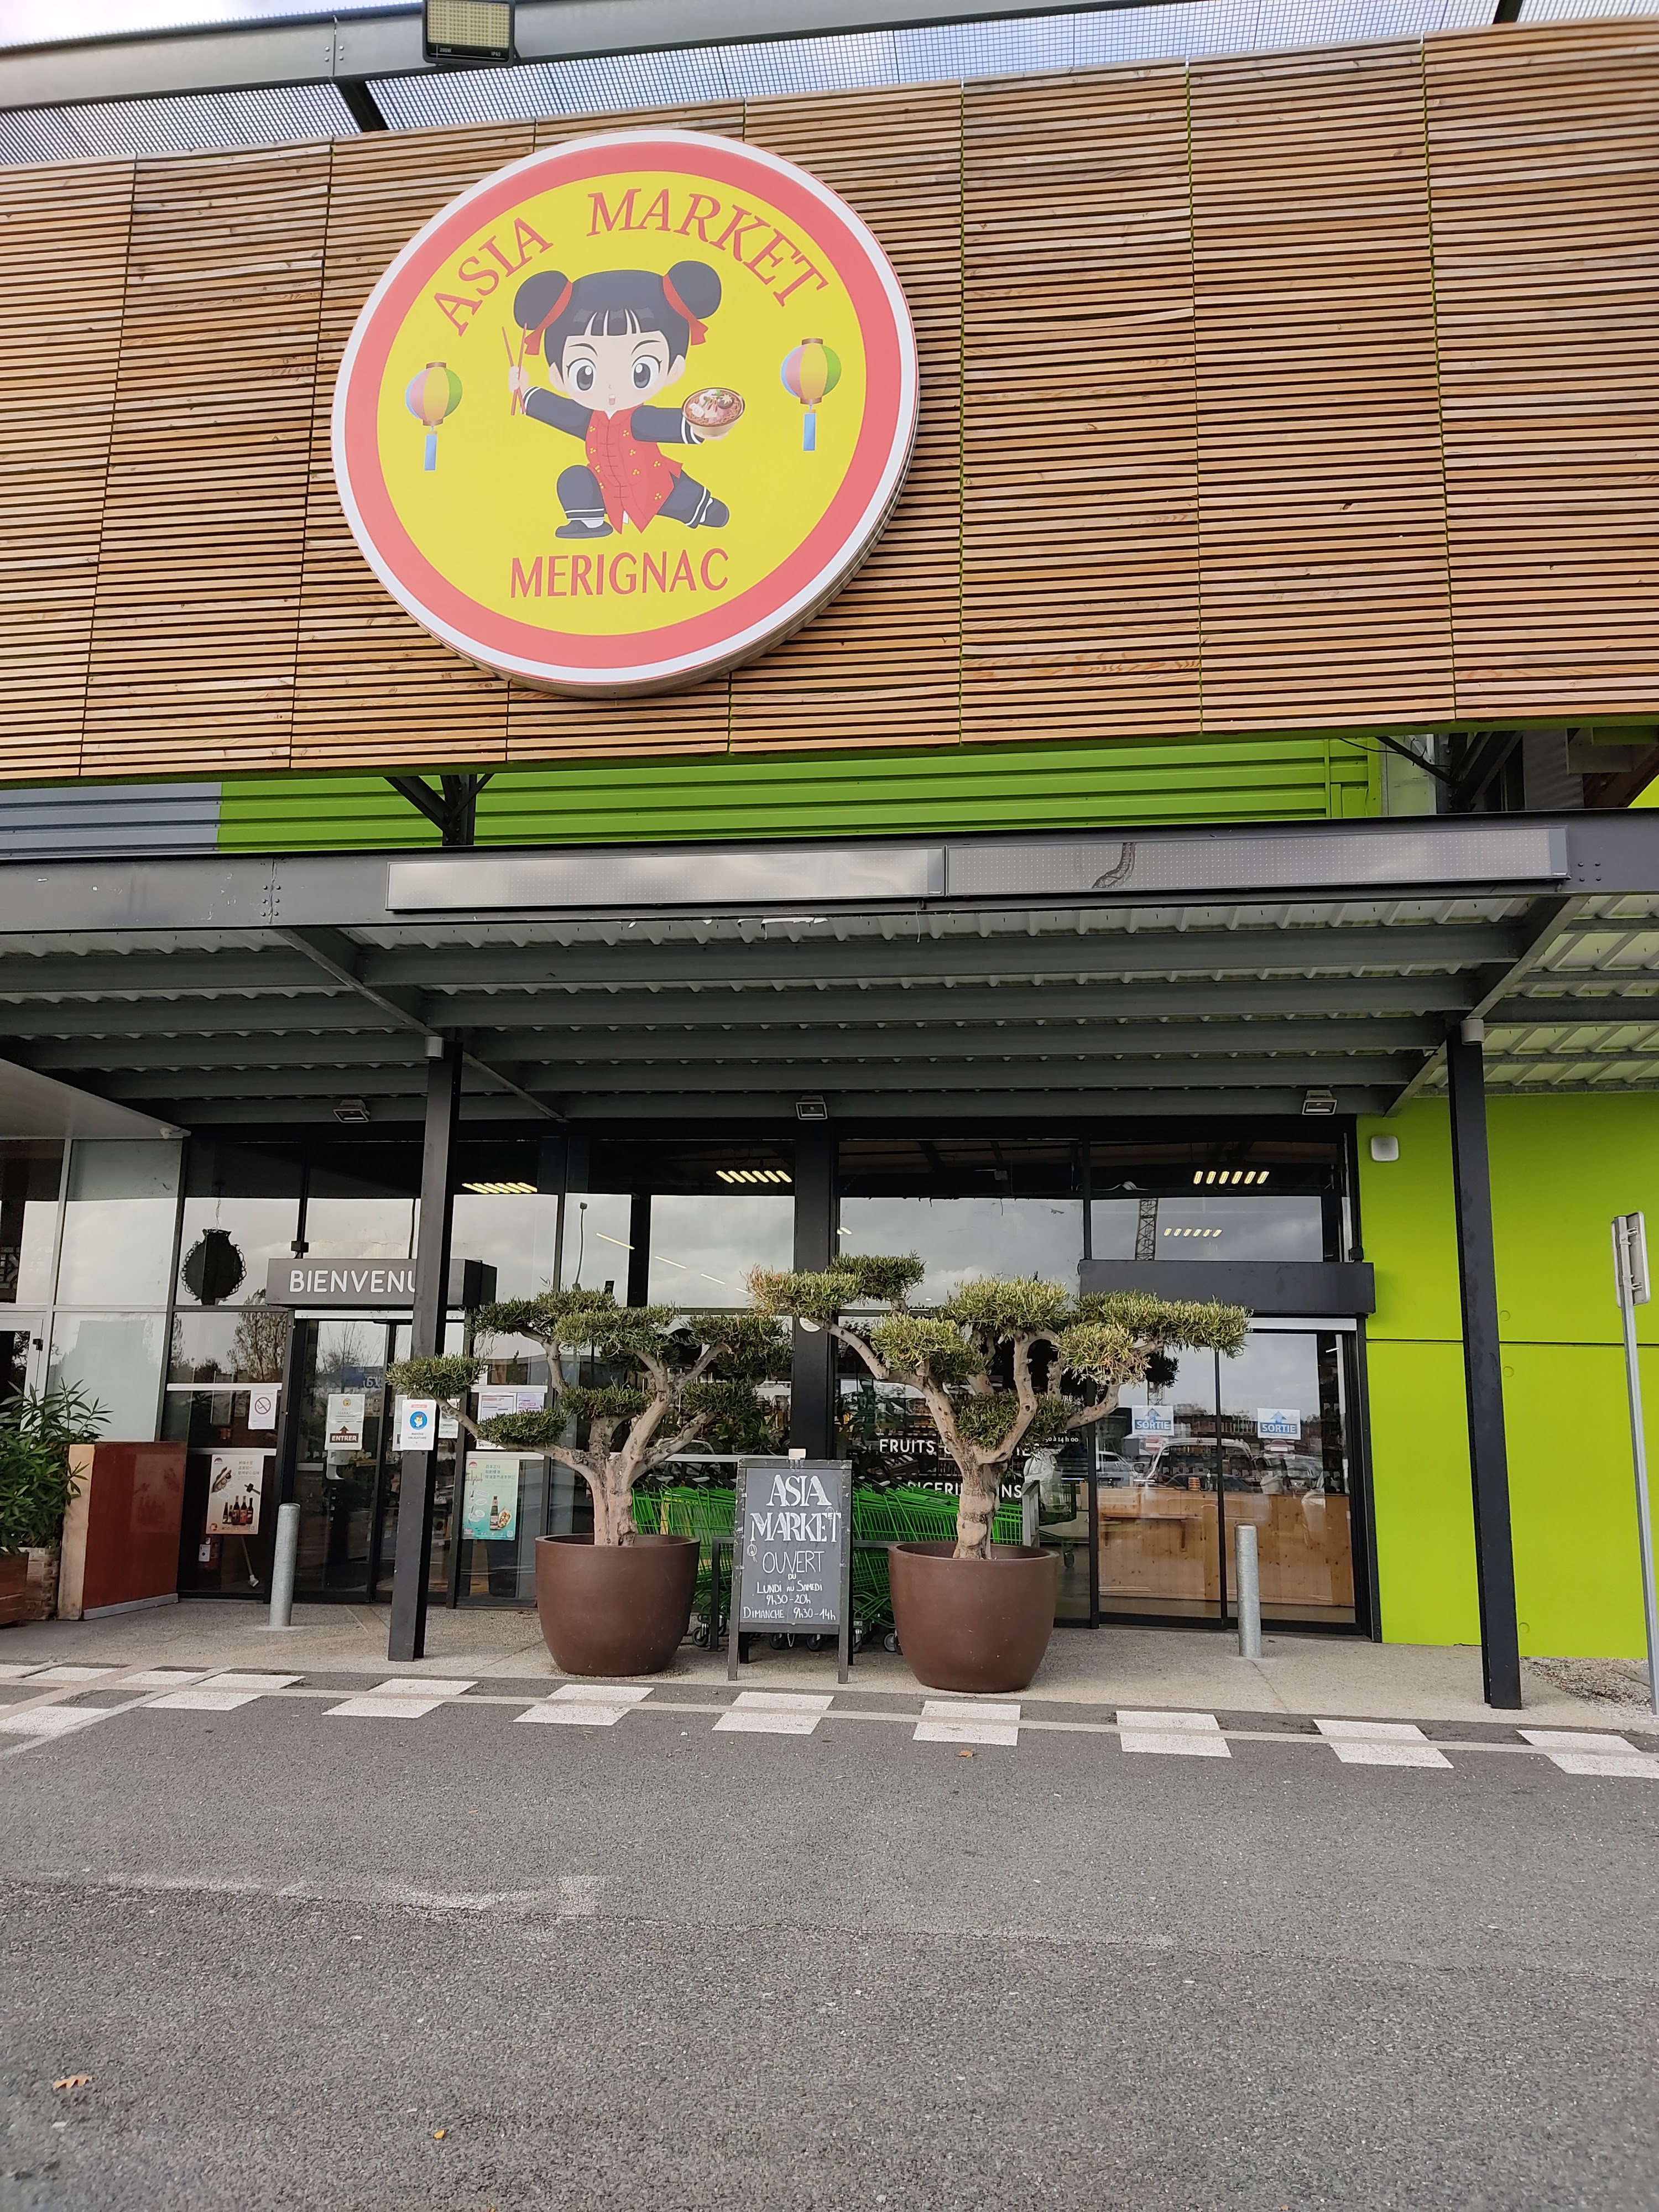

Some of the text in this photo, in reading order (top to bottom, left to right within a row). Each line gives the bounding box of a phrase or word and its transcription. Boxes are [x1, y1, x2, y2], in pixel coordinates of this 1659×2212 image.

[433, 189, 829, 336] ASIA MARKET
[510, 548, 729, 598] MERIGNAC
[1136, 1421, 1170, 1430] SORTIE
[1262, 1424, 1296, 1433] SORTIE
[879, 1438, 935, 1454] FRUITS
[766, 1474, 832, 1507] ASIA
[750, 1512, 841, 1543] MARKET
[762, 1550, 825, 1574] OUVERT
